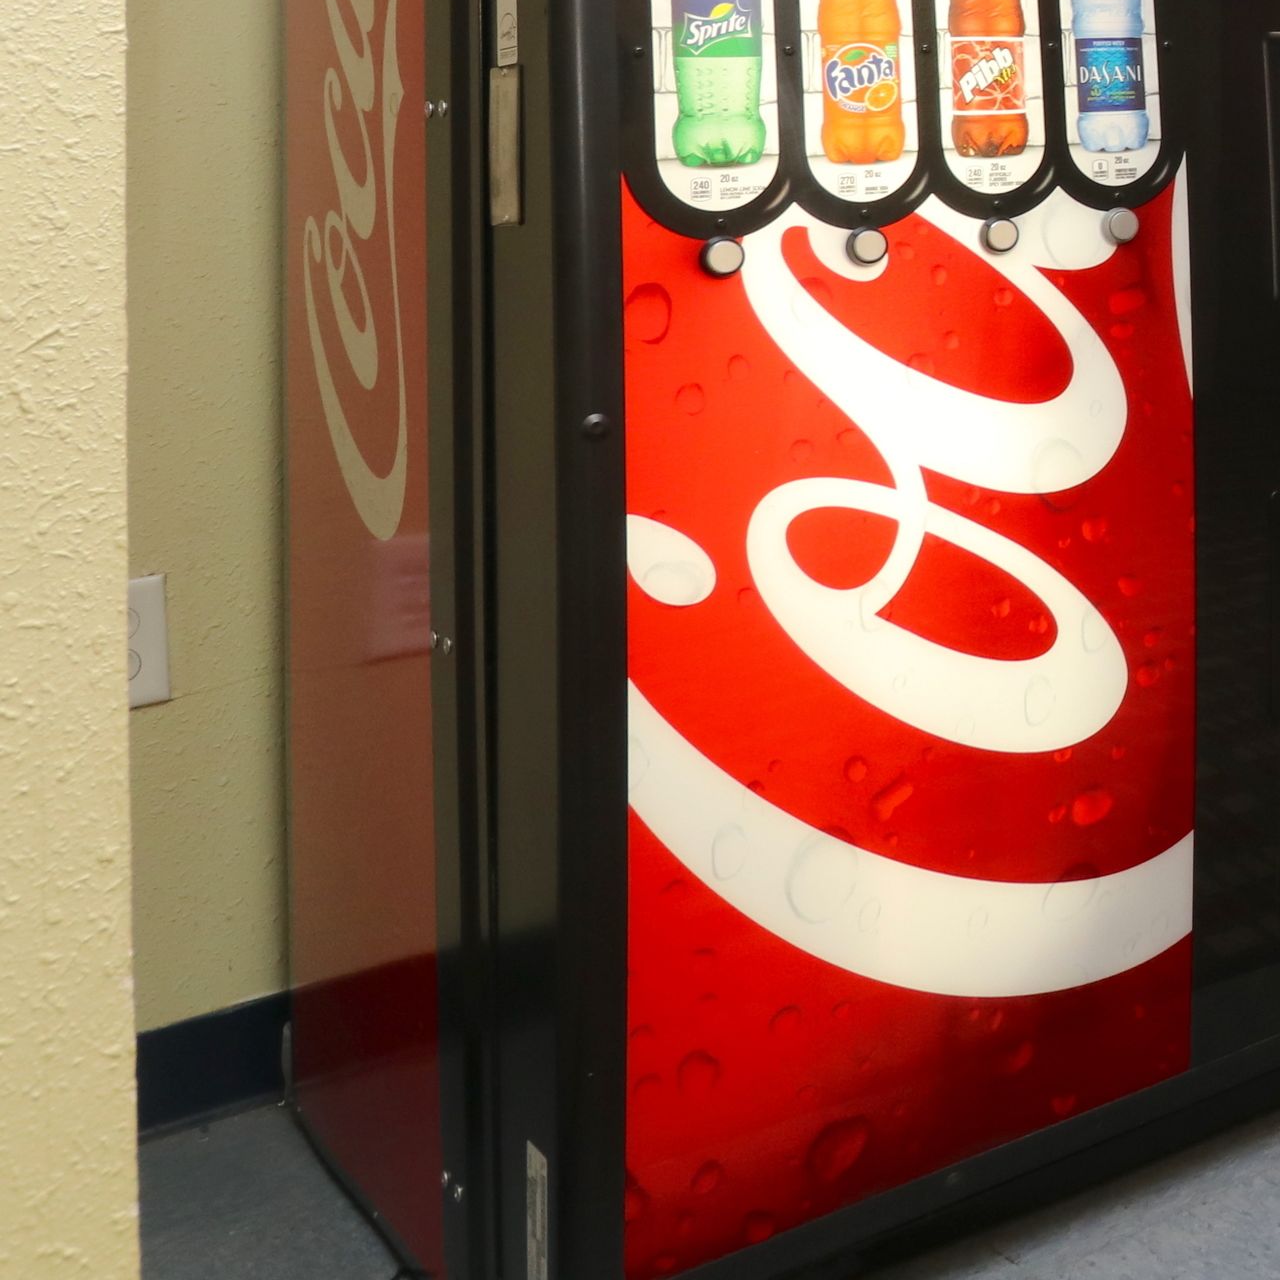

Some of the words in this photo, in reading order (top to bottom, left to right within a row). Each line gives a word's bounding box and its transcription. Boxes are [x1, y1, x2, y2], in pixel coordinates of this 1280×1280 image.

[686, 11, 747, 46] Sprite
[825, 53, 894, 100] Fanta
[959, 47, 1014, 104] Pibb
[1079, 60, 1141, 87] DASANI
[693, 181, 710, 190] 240
[720, 174, 730, 182] 20
[840, 176, 855, 185] 270
